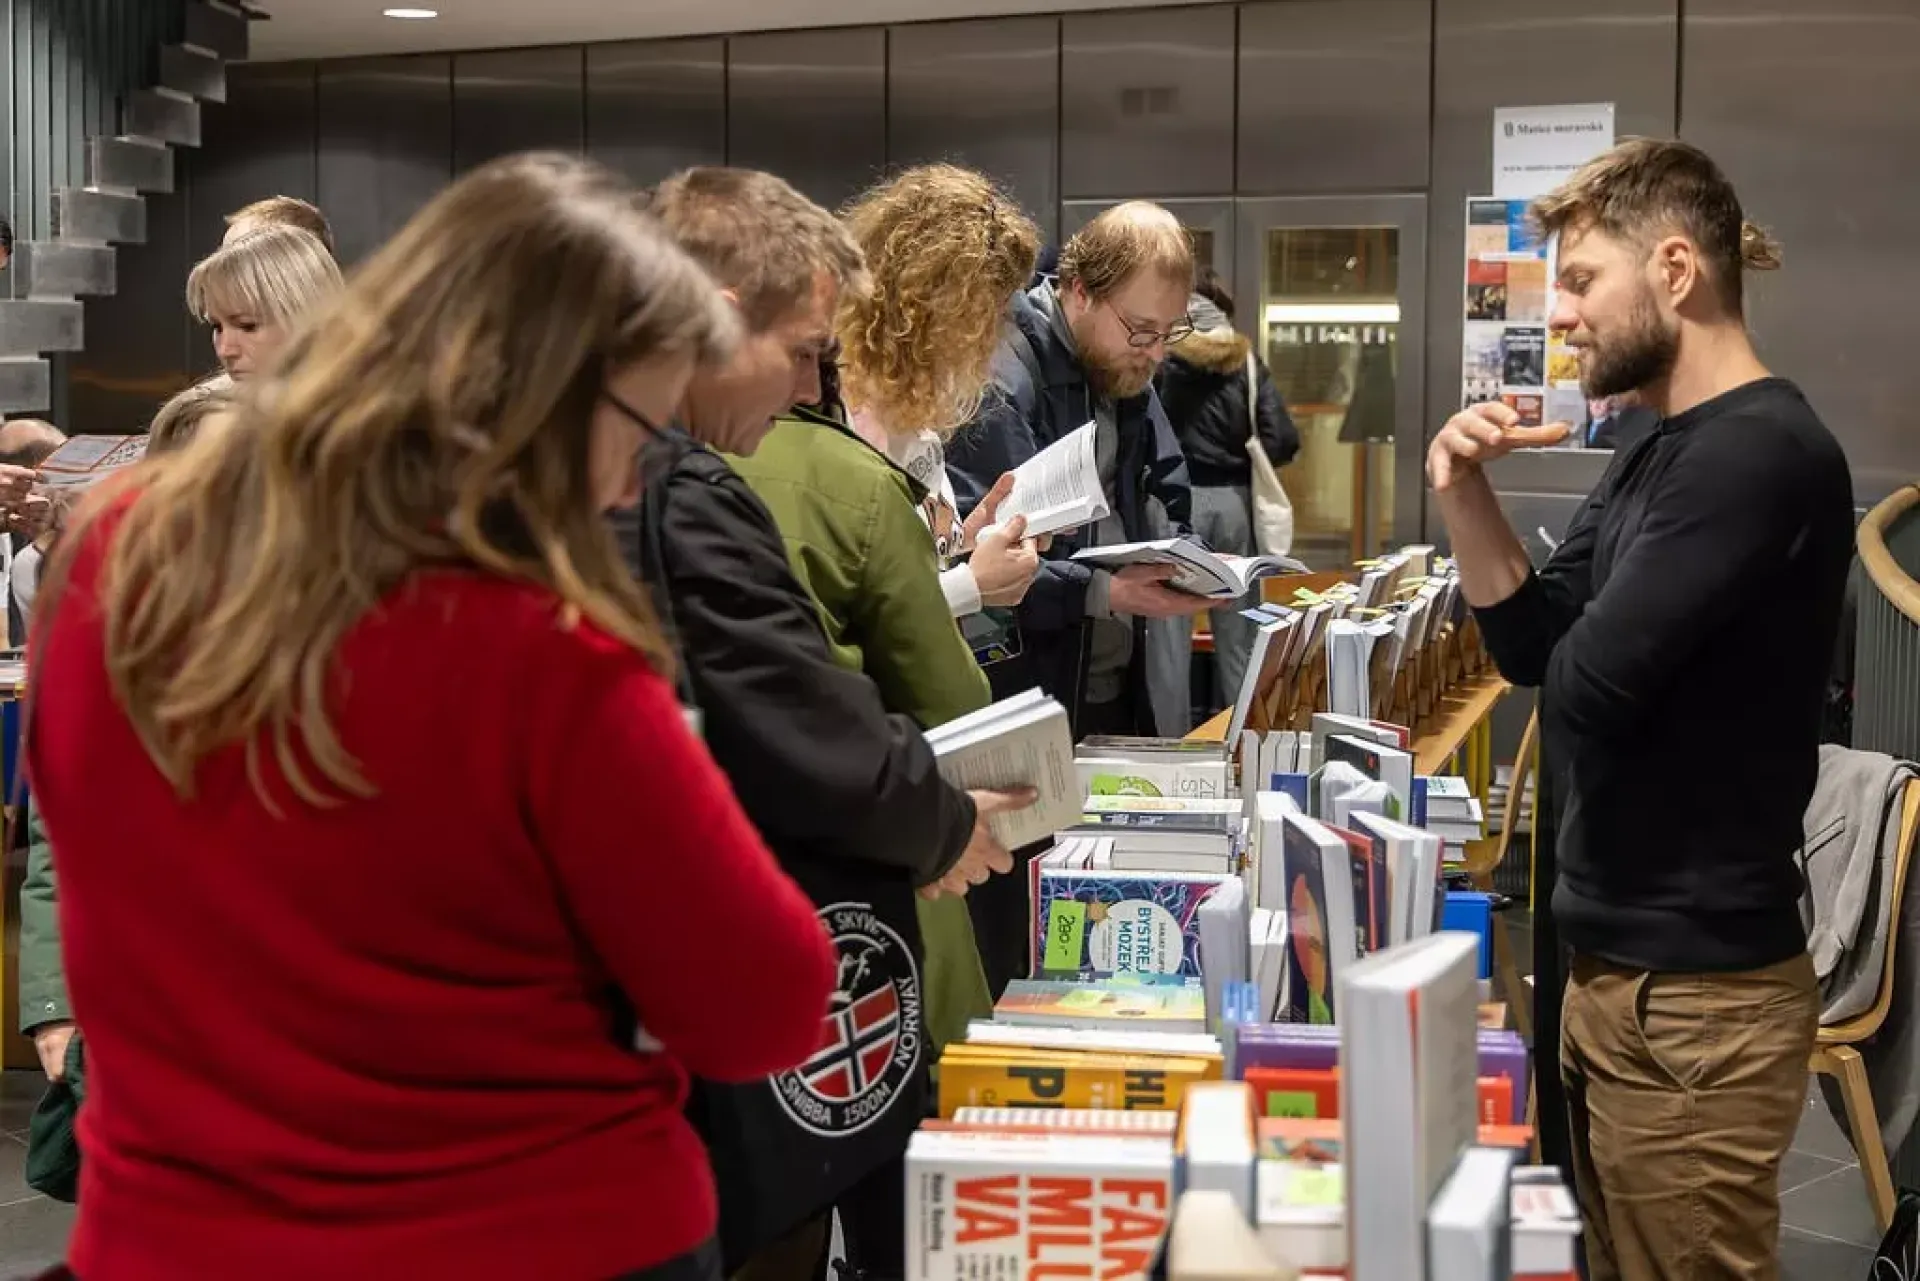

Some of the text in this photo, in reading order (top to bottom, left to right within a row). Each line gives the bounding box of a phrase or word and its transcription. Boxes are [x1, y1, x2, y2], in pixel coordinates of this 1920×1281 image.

[1117, 920, 1132, 972] MOZEK
[895, 975, 919, 1069] NORWAY
[955, 1174, 1019, 1245] VA
